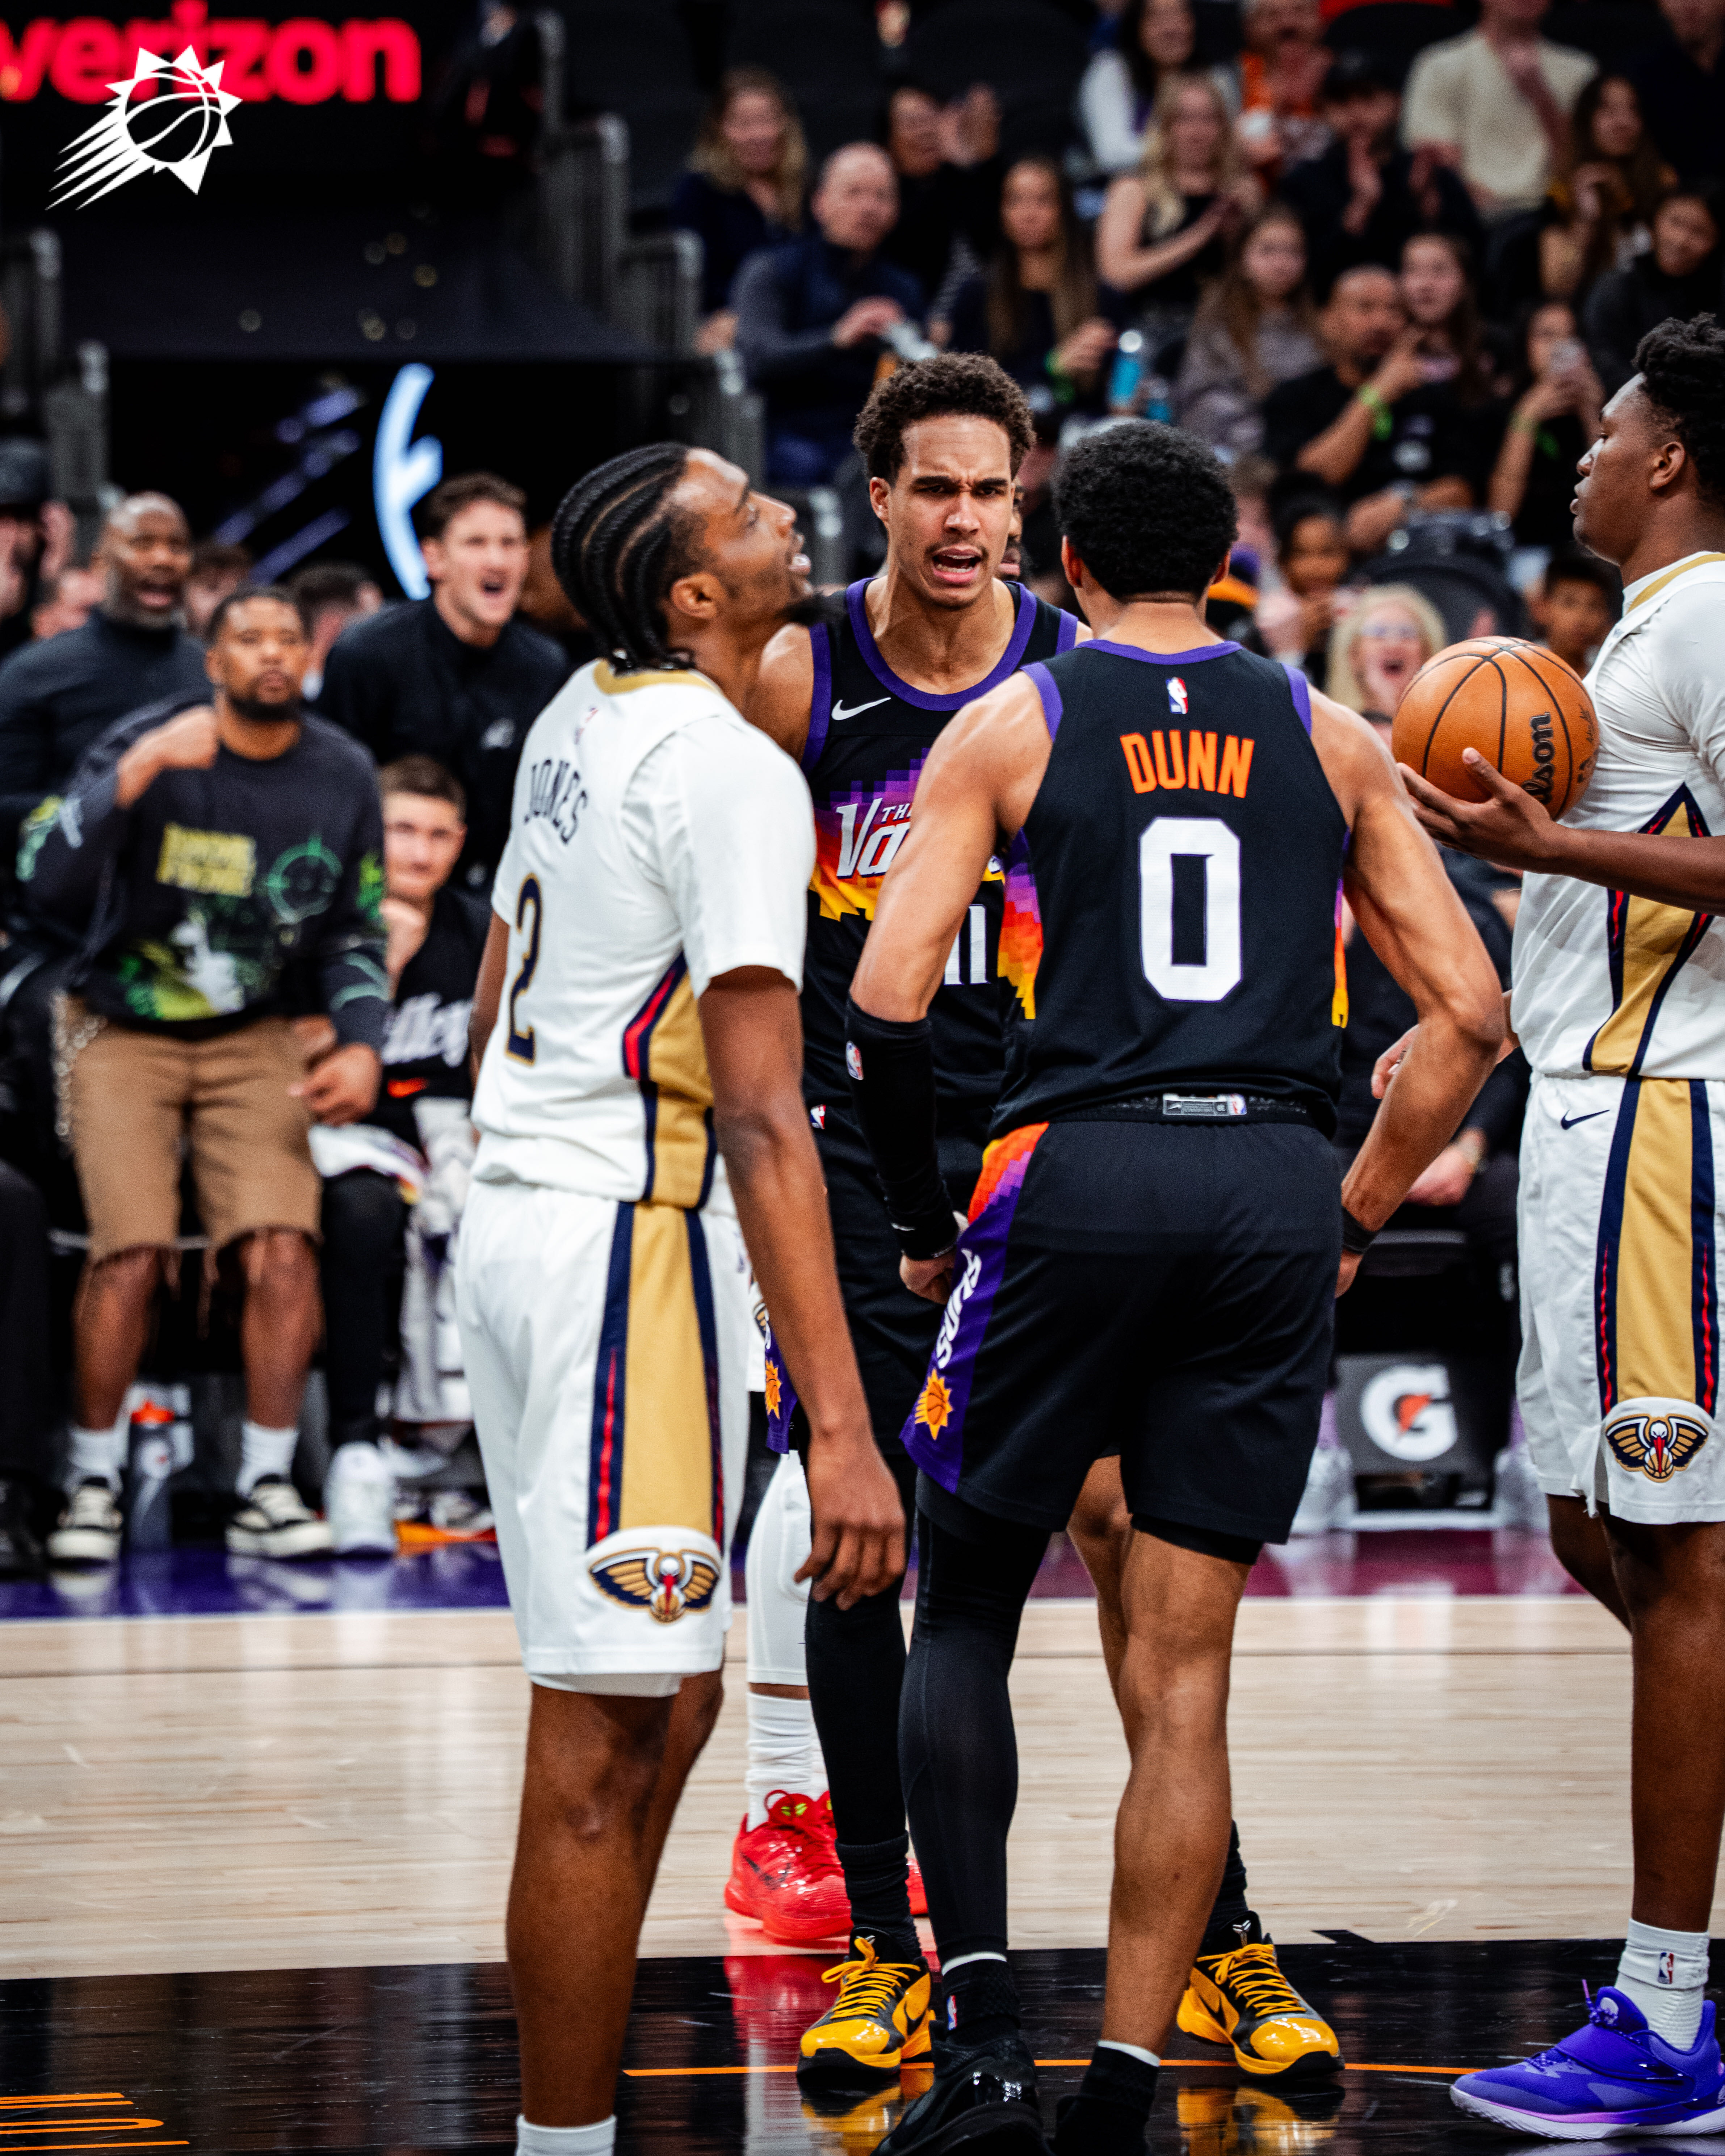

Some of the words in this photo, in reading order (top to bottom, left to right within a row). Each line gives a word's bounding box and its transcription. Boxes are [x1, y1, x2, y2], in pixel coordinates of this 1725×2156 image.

[524, 758, 589, 846] JONES
[1119, 730, 1255, 798] DUNN
[504, 872, 543, 1067] 2
[1139, 816, 1242, 1002] 0
